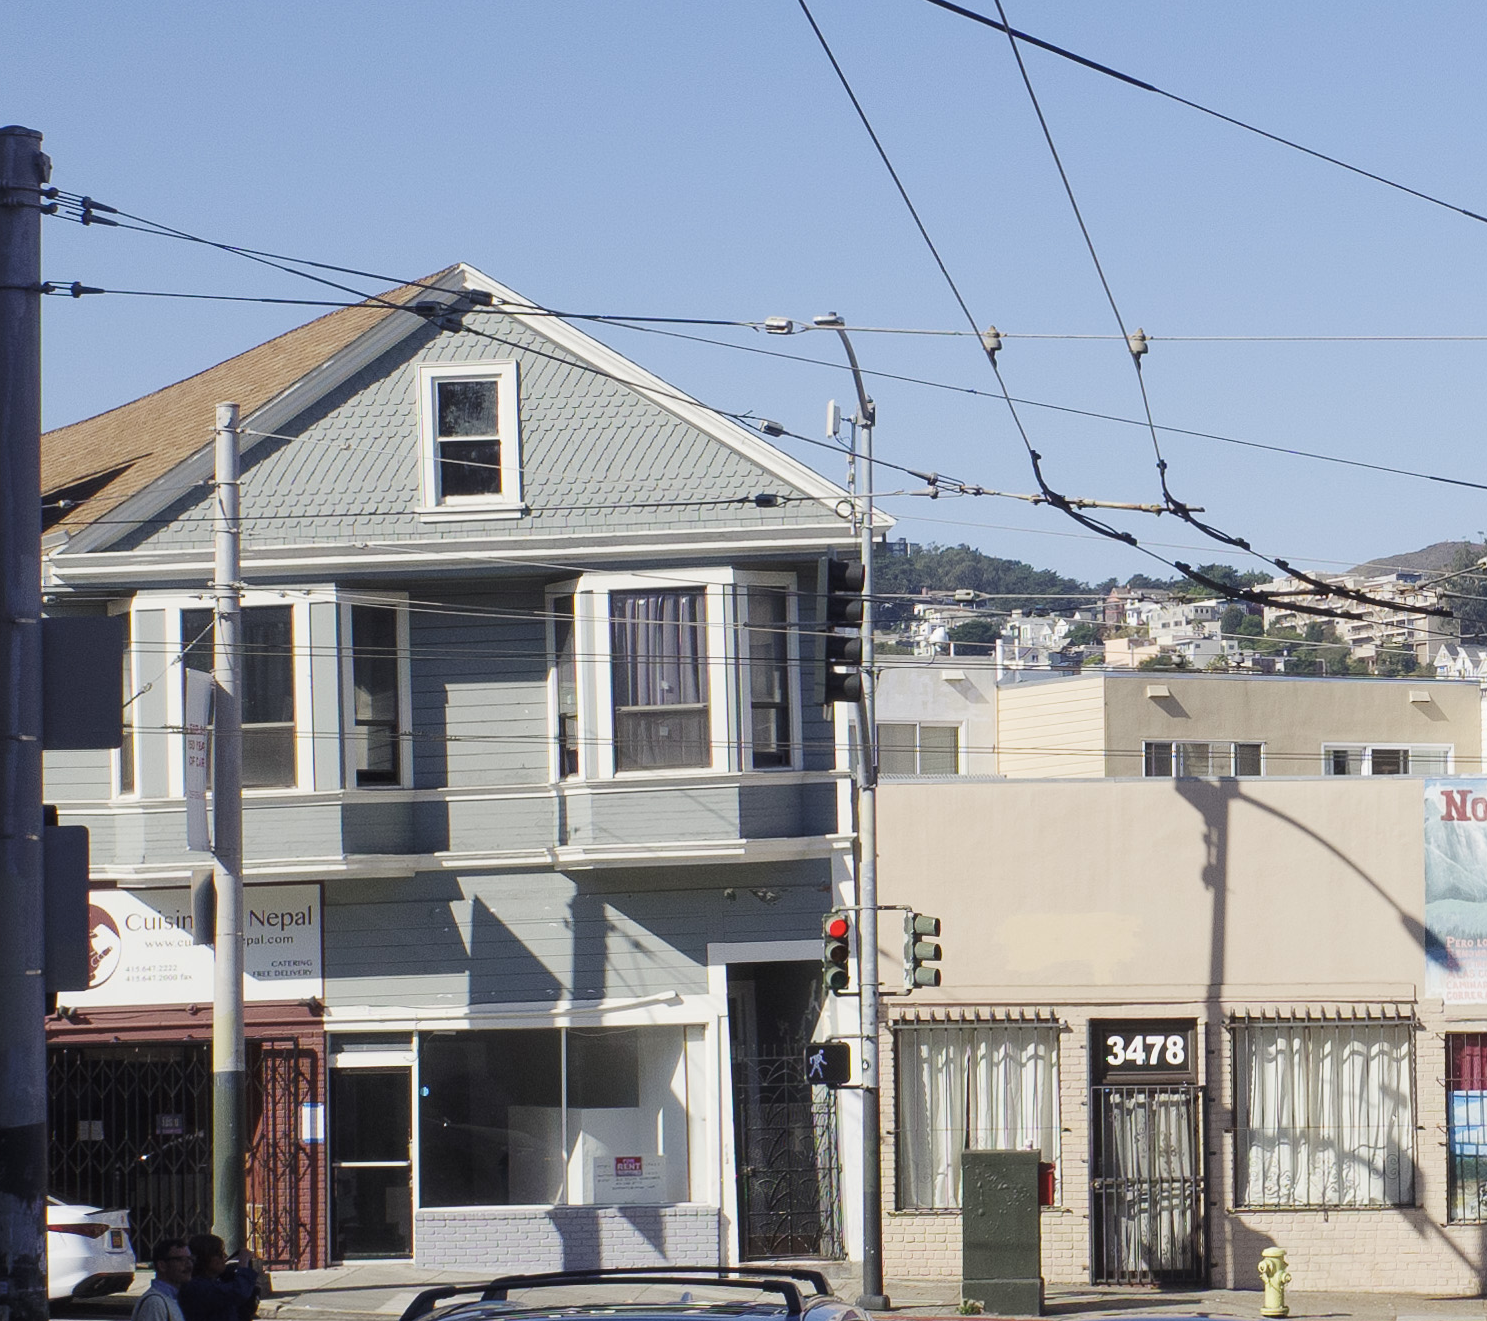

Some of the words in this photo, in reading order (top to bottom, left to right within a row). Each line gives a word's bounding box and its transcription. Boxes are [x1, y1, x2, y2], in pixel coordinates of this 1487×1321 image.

[248, 904, 312, 931] Nepal
[271, 960, 312, 968] CATERING
[274, 969, 312, 978] DELIVERY
[1106, 1035, 1185, 1065] 3478
